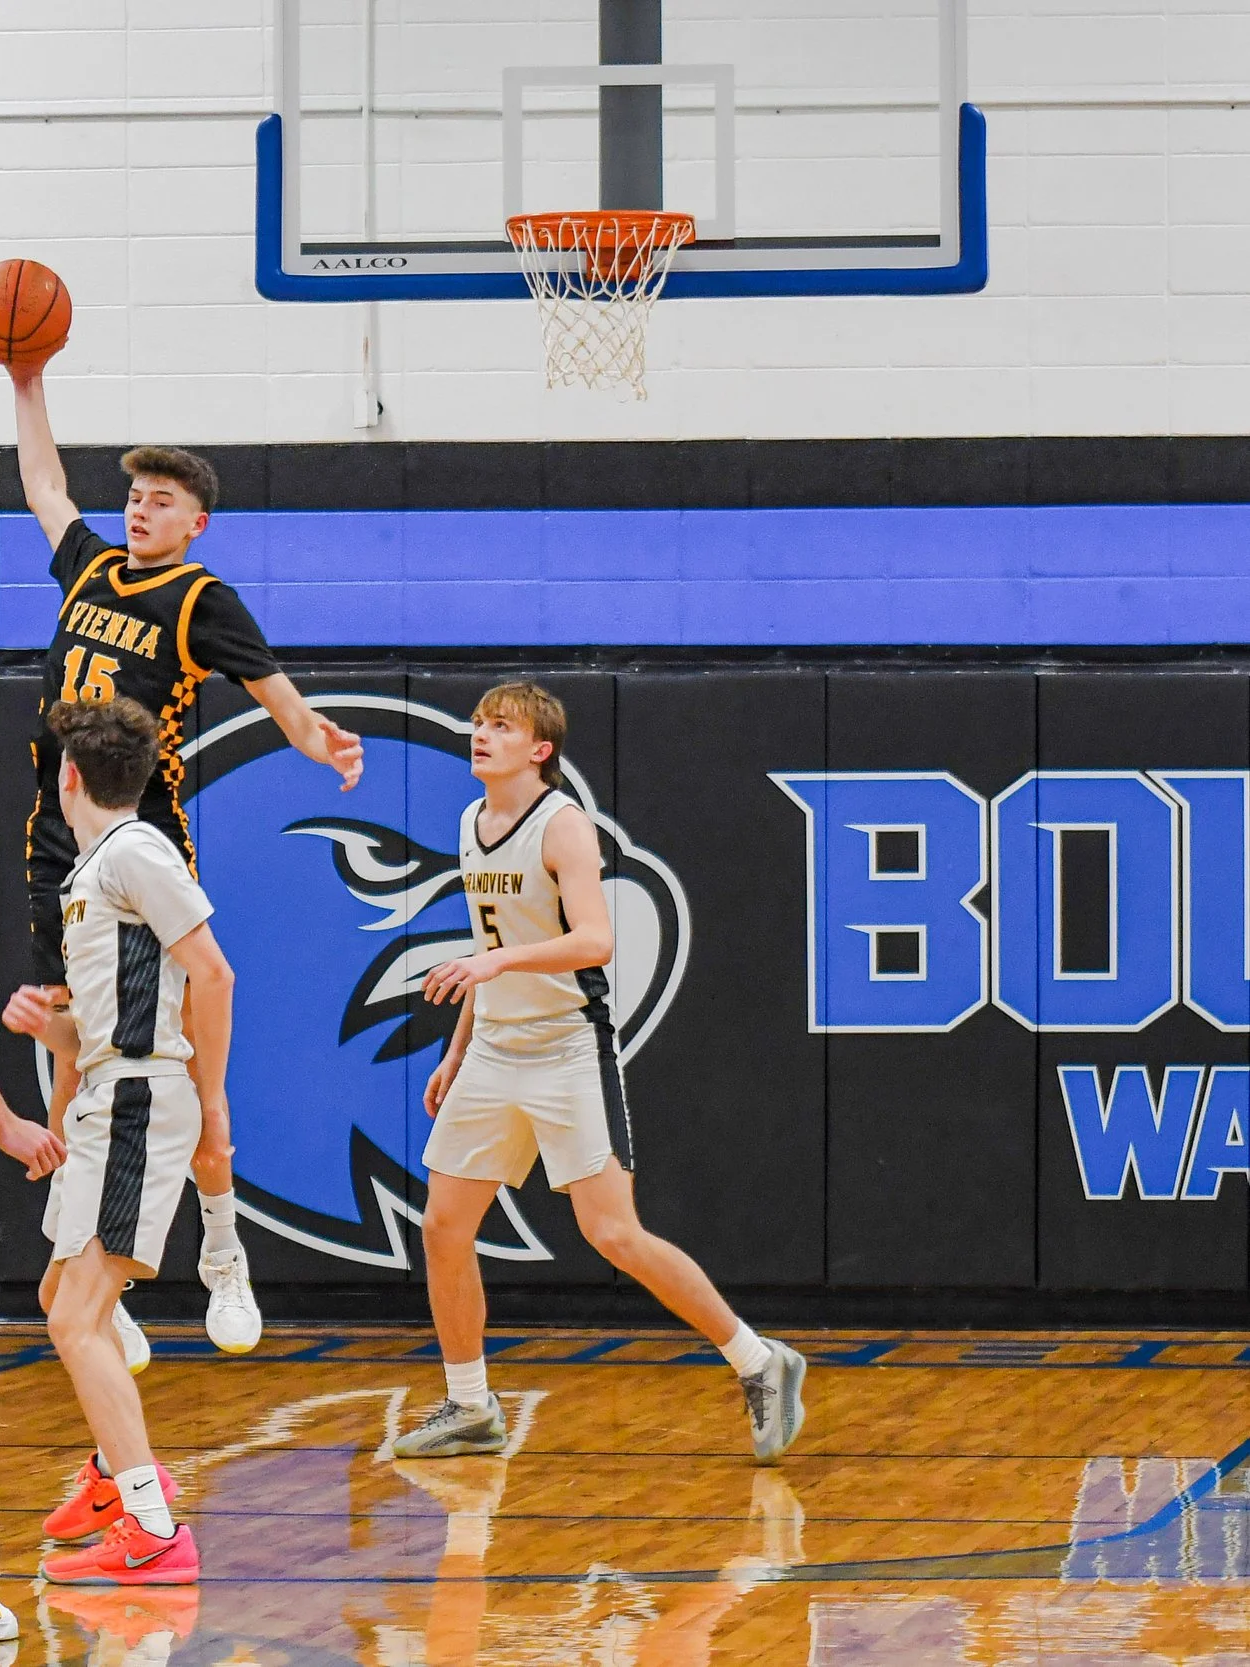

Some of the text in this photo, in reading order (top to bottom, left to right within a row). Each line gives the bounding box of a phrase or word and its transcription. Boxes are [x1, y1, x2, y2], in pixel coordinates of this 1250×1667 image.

[312, 257, 408, 270] AALCO
[65, 601, 162, 660] VIENNA
[60, 644, 122, 704] 15
[478, 902, 504, 951] 5
